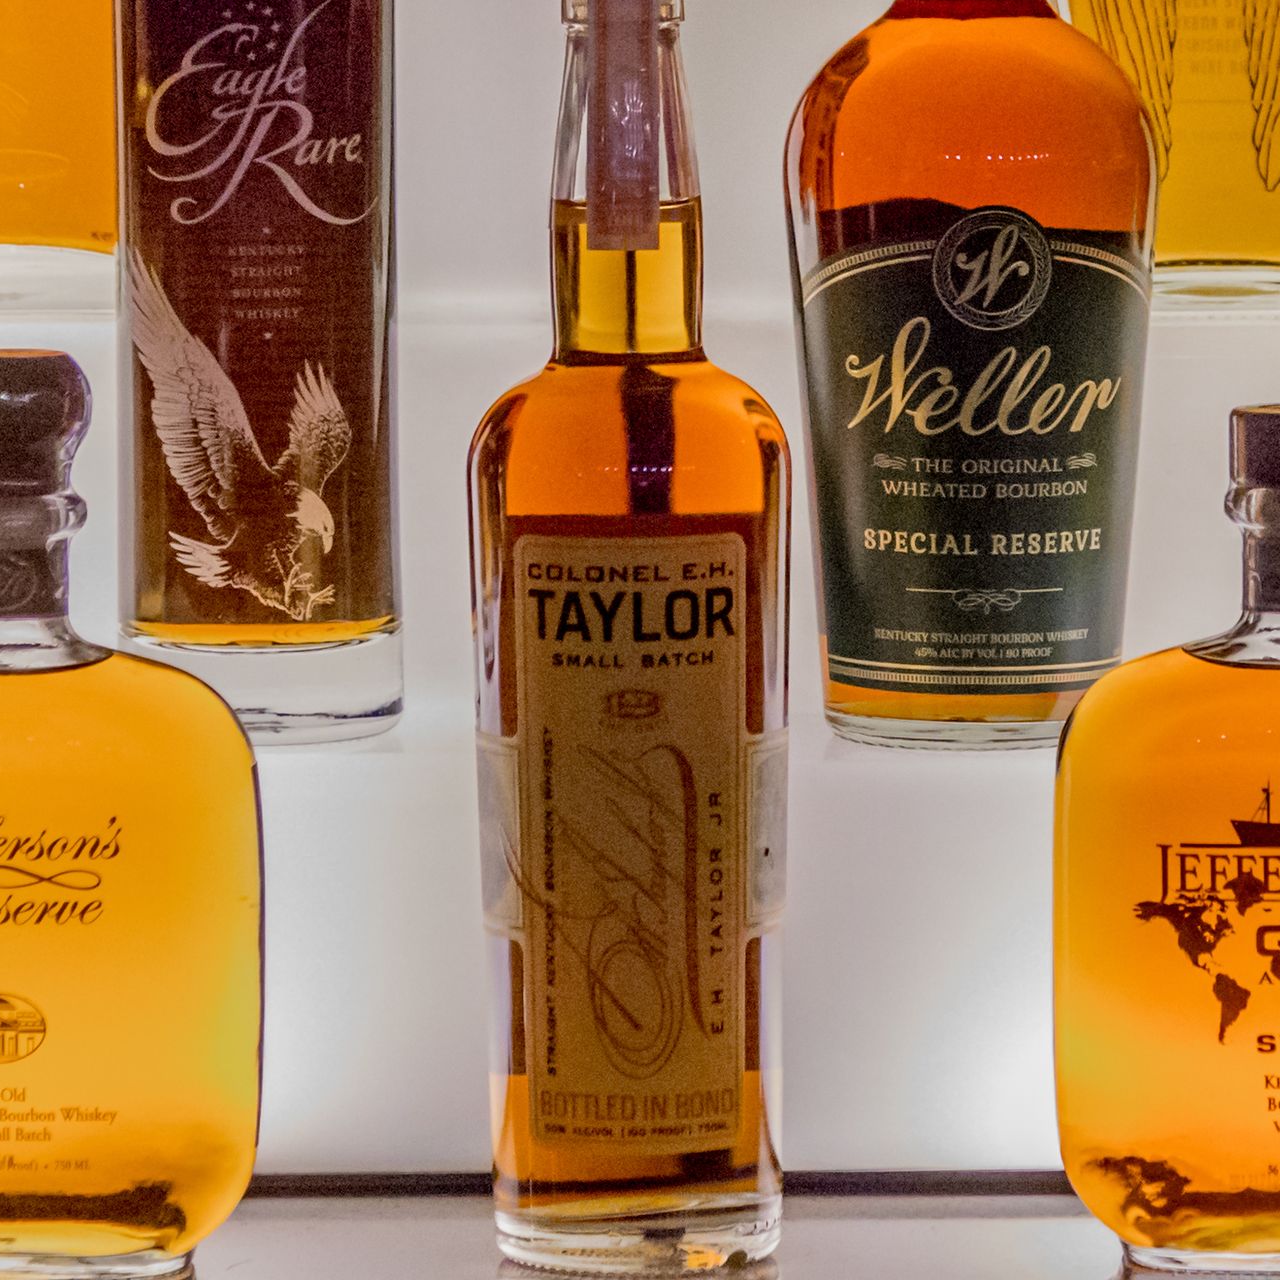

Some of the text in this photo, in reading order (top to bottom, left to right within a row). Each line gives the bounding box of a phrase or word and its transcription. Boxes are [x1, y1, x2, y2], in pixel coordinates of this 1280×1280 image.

[171, 99, 379, 225] Rare
[228, 245, 305, 257] KENTUCKY
[231, 265, 302, 278] STRAIGHT
[953, 225, 1029, 308] W
[233, 287, 302, 299] BOURBON
[235, 307, 300, 319] WHISKEY
[846, 317, 1120, 436] Weller
[911, 457, 1063, 473] THE ORIGINAL
[881, 480, 1088, 499] WHEATED BOURBON
[864, 528, 1102, 555] SPECIAL RESERVE
[527, 561, 734, 583] COLONEL E.H.
[527, 587, 735, 643] TAYLOR
[874, 628, 1089, 644] KENTUCKY STRAIGHT BOURBON WHISKEY
[552, 650, 715, 668] SMALL BATCH
[1021, 646, 1054, 658] PROOF
[0, 1086, 26, 1102] Old
[540, 1087, 735, 1120] BOTTLED IN BOND
[60, 1106, 118, 1125] Whiskey
[15, 1126, 52, 1142] Batch
